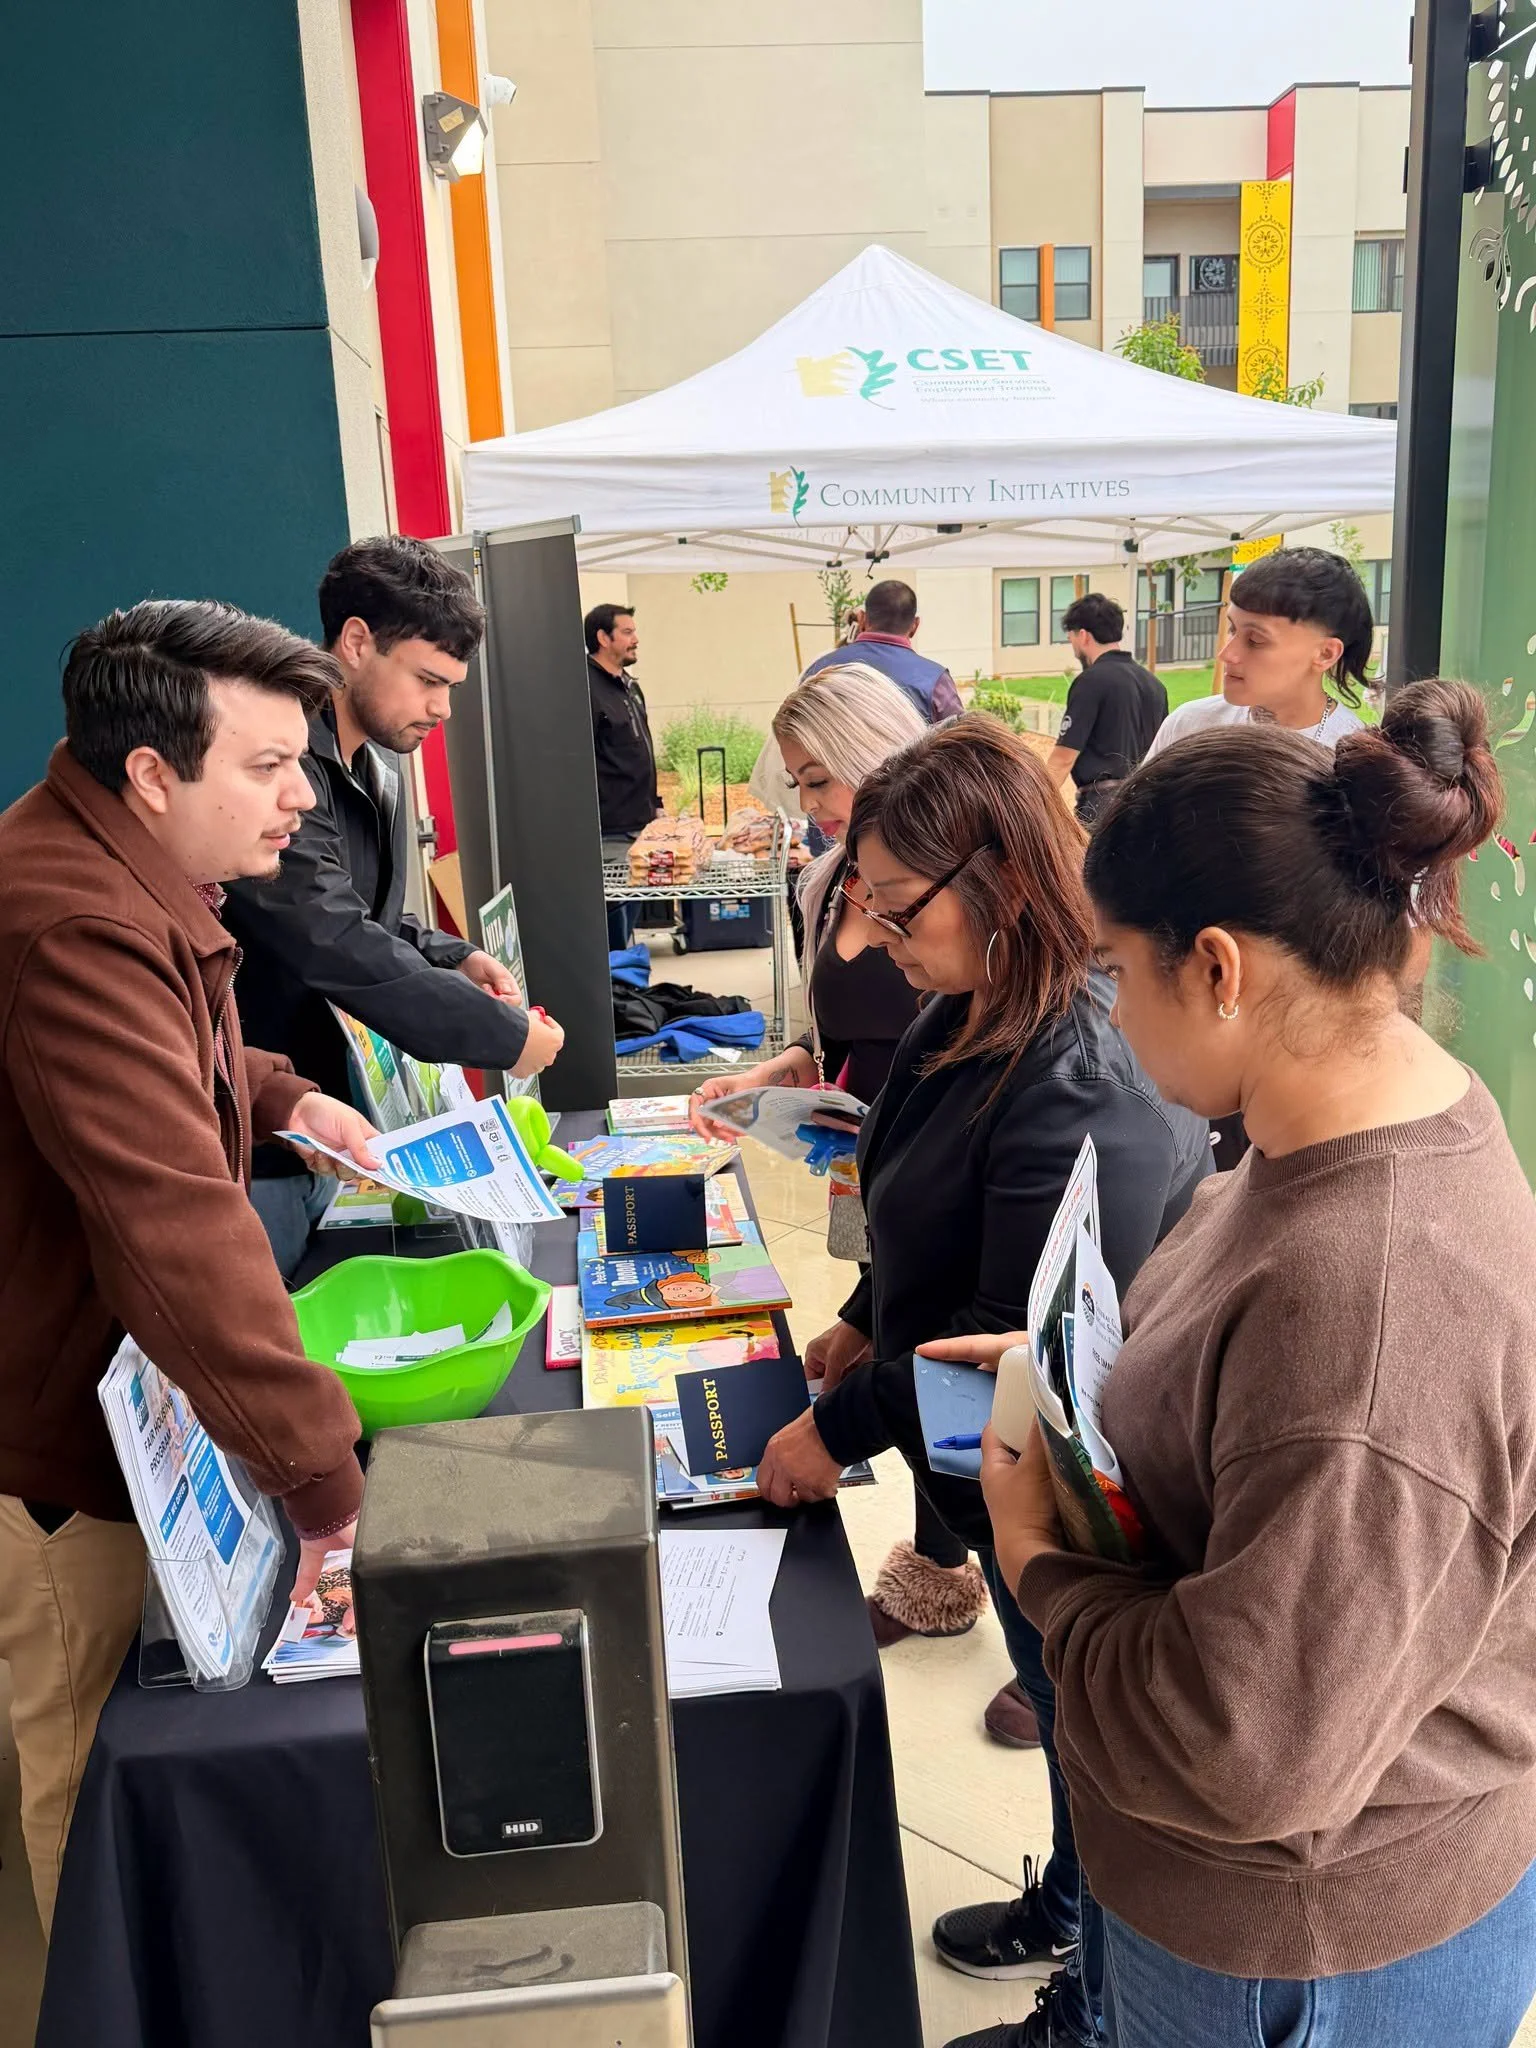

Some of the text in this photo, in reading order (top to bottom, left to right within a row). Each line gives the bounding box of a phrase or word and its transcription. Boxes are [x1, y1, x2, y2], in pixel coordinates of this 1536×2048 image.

[906, 349, 1032, 371] CSET
[820, 479, 1130, 507] COMMUNITY INITIATIVES
[624, 1185, 638, 1246] PASSPORT
[143, 1394, 175, 1455] FAIR HOUSING
[702, 1378, 729, 1461] PASSPORT
[149, 1430, 173, 1476] PROGRAM
[505, 1822, 539, 1835] HID
